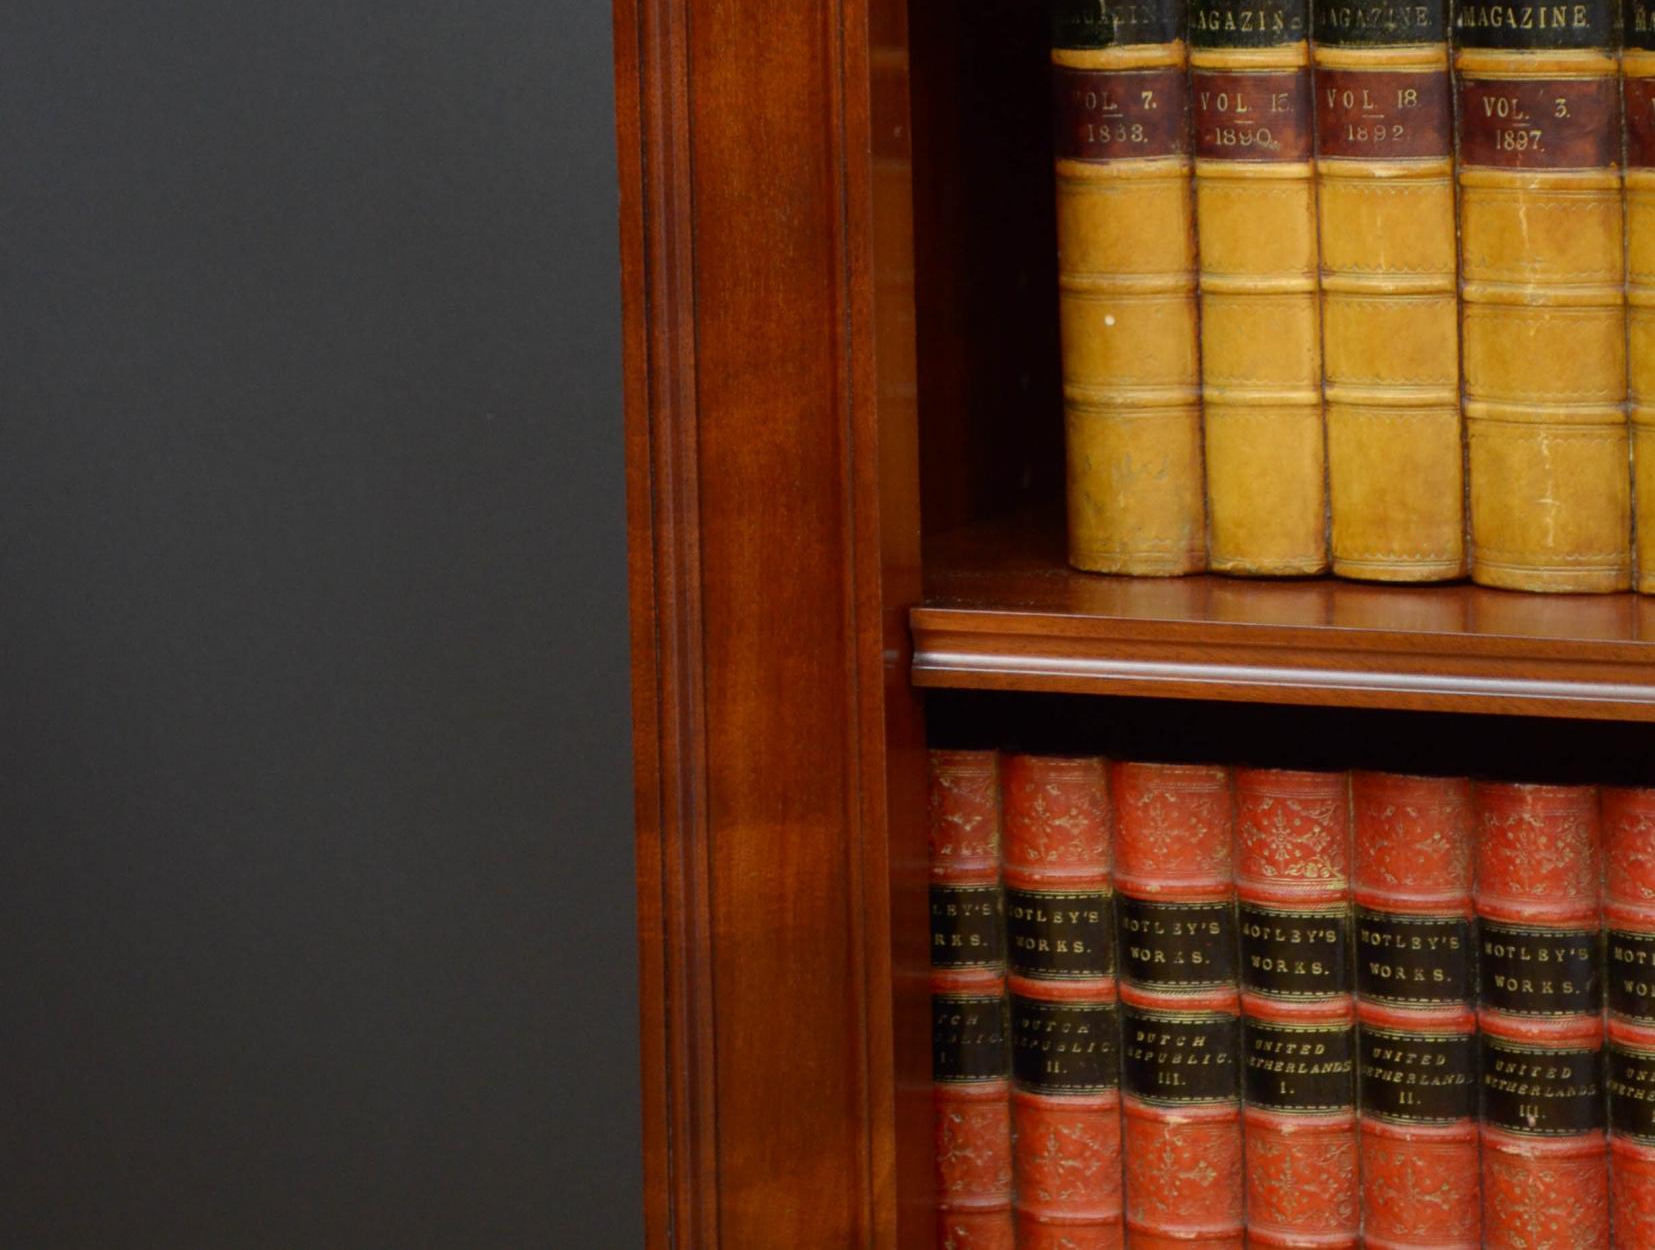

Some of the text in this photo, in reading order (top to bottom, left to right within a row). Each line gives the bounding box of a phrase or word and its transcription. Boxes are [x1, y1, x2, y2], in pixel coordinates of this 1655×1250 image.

[1462, 5, 1591, 30] MAGAZINE.
[1483, 96, 1571, 120] VOL. 3.
[1251, 954, 1330, 975] WORKS.
[1368, 961, 1453, 982] WORKS.
[1494, 974, 1581, 995] WORKS.
[1624, 979, 1655, 997] WO
[1136, 1030, 1208, 1048] DUTCH
[1254, 1038, 1326, 1056] UNITED
[1371, 1047, 1447, 1066] UNITED
[1495, 1059, 1573, 1080] UNITED
